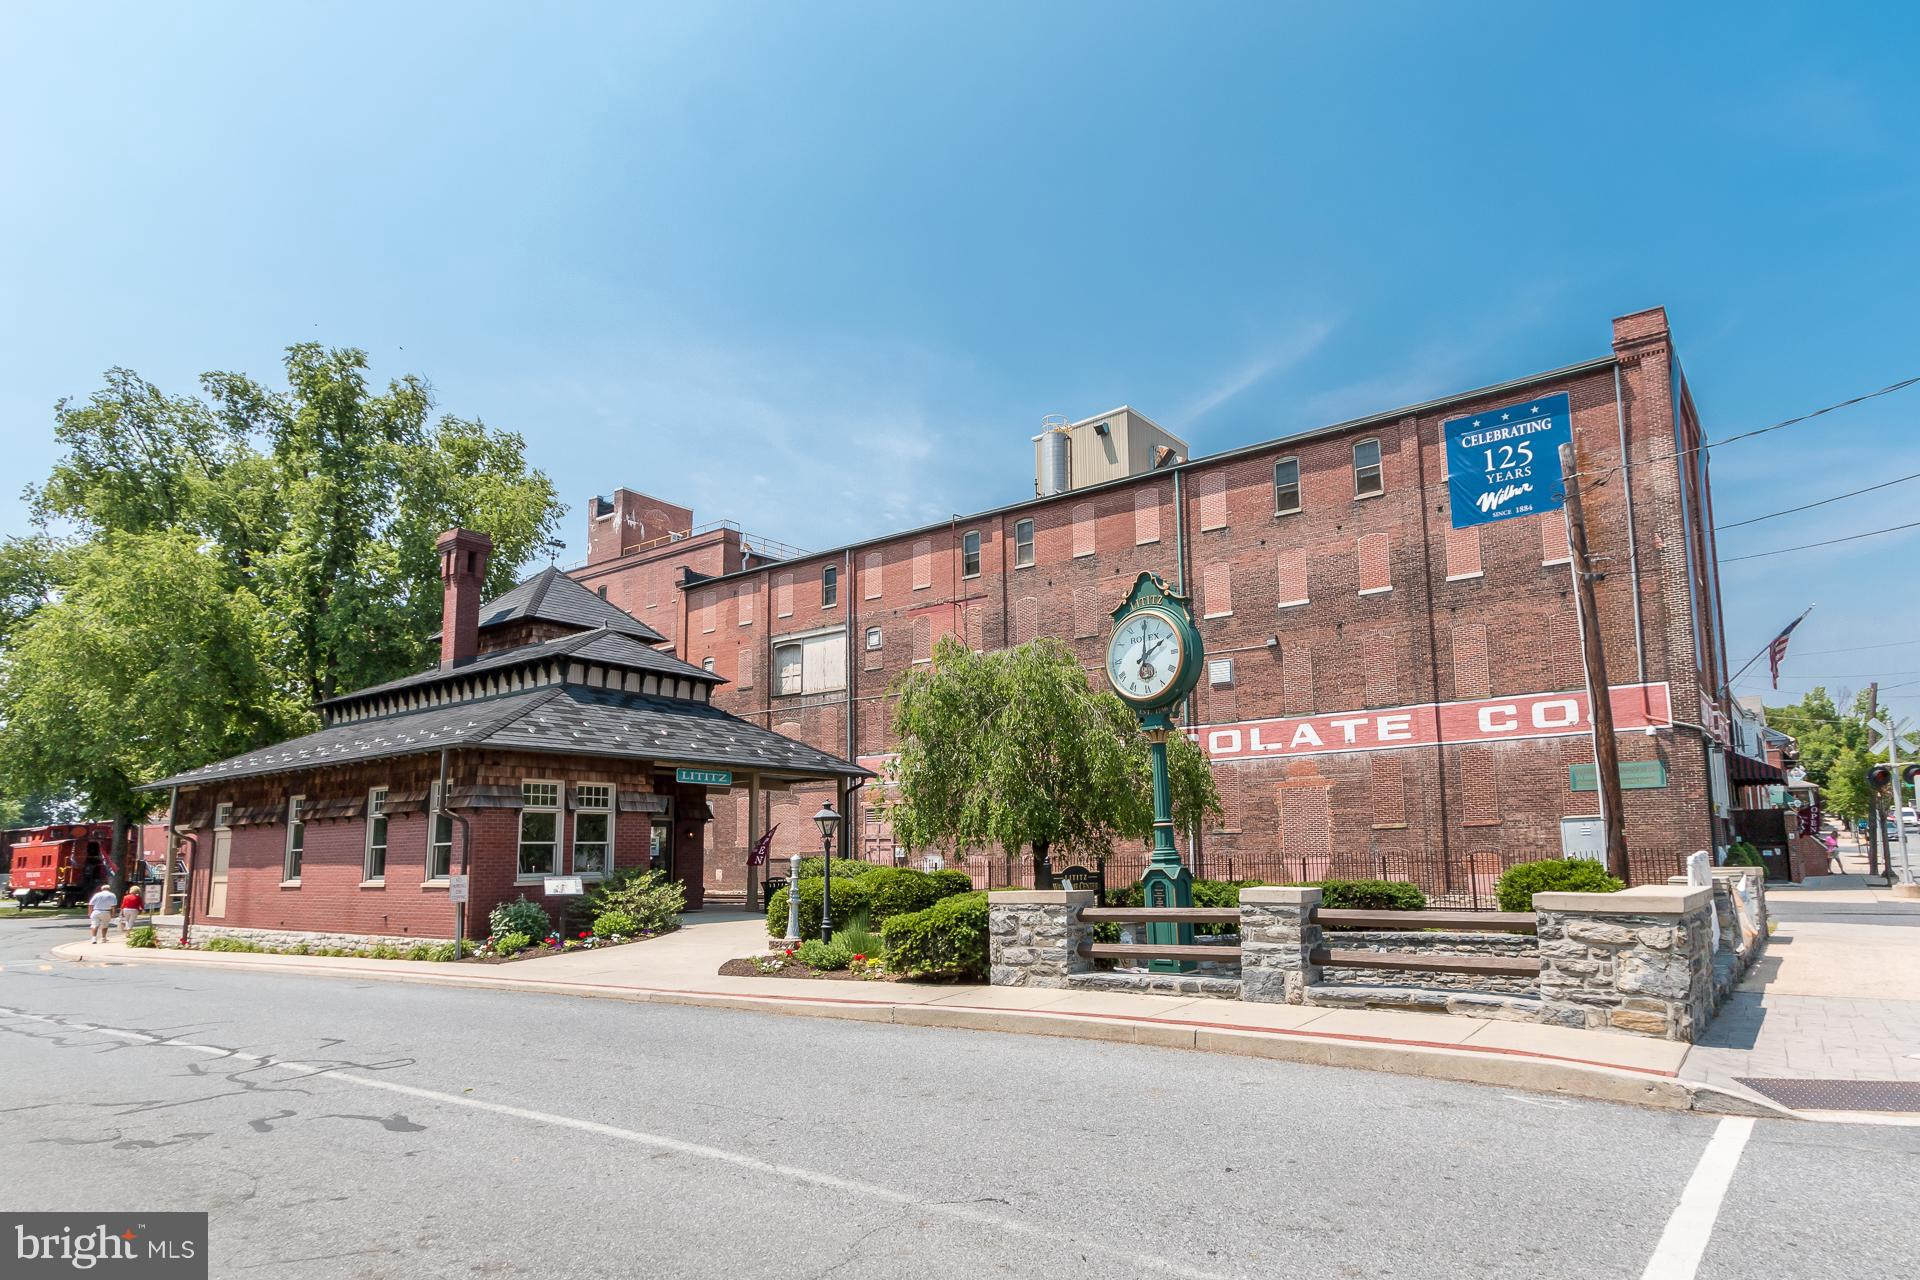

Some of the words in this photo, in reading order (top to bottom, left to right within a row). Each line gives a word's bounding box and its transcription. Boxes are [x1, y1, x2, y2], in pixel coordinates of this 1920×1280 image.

[1461, 418, 1552, 448] CELEBRATING
[1484, 441, 1533, 472] 125
[1486, 466, 1532, 484] YEARS
[1476, 483, 1534, 512] Wilbur
[1492, 509, 1512, 517] SINCE
[1515, 504, 1533, 513] 1884
[1130, 595, 1163, 610] LITITZ
[1130, 632, 1160, 645] ROEX
[1188, 714, 1411, 754] OLATE
[682, 771, 727, 782] LITITZ
[1810, 806, 1818, 832] OPEN
